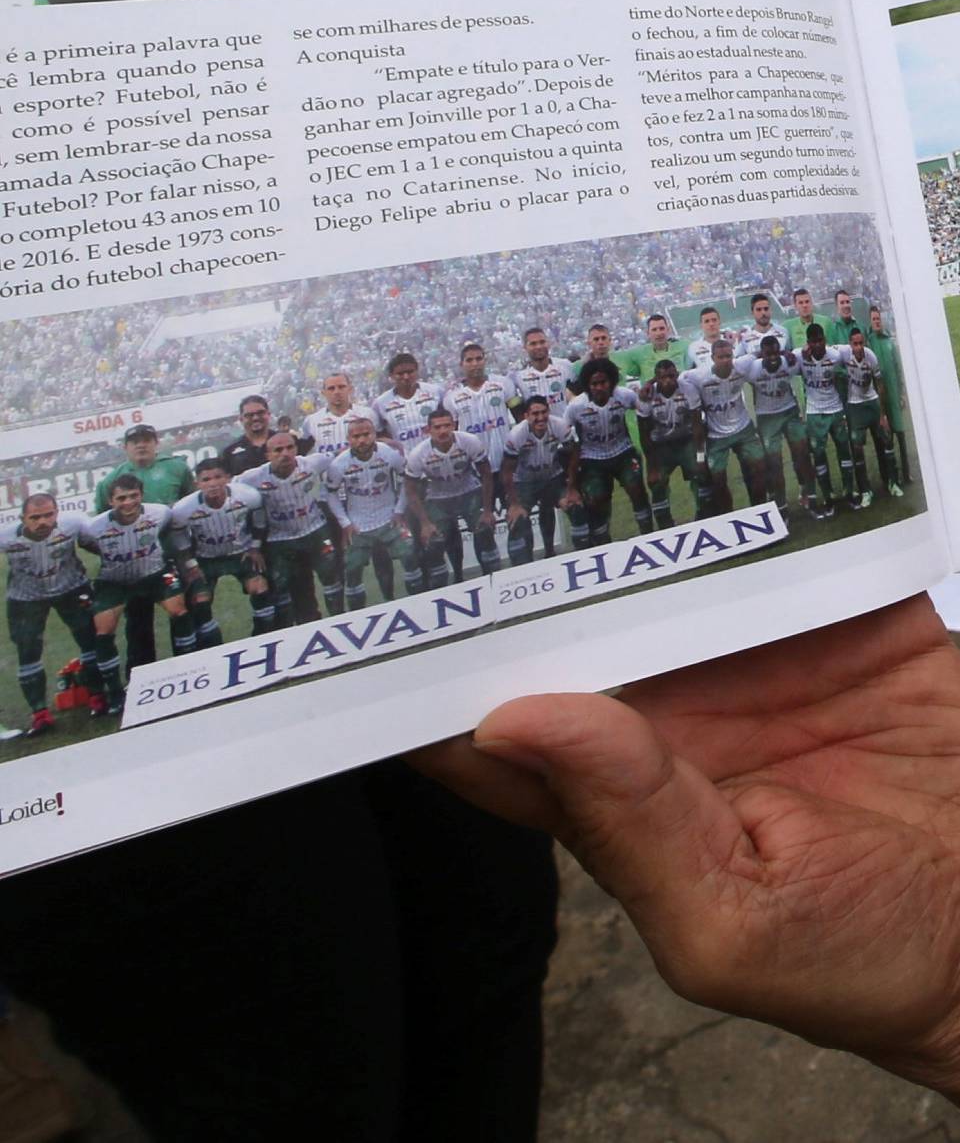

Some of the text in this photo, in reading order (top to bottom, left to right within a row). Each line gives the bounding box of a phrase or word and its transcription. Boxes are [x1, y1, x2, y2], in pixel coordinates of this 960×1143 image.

[294, 15, 535, 39] se com milhares de pessoas.
[6, 35, 262, 65] é a primeira palavra que
[297, 45, 405, 64] A conquista
[458, 65, 468, 75] e
[472, 59, 518, 74] título
[522, 60, 560, 75] para
[564, 59, 573, 68] o
[577, 54, 610, 67] Ver-
[636, 47, 675, 61] finais
[678, 50, 694, 59] ao
[696, 45, 752, 58] estadual
[753, 47, 783, 57] neste
[28, 58, 264, 86] lembra quando pensa
[13, 77, 267, 117] esporte? Futebol, não é
[12, 105, 270, 139] como é possível pensar
[15, 129, 272, 165] sem lembrar-se da nossa
[306, 119, 620, 165] pecoense empatou em Chapecó com
[78, 159, 196, 183] Associação
[202, 153, 274, 171] Chape-
[312, 161, 626, 208] taça no Catarinense. No início,
[654, 175, 680, 189] vel,
[687, 171, 734, 191] porém
[740, 171, 768, 181] com
[774, 164, 849, 181] complexidades
[2, 177, 278, 218] Futebol? Por falar nisso, a
[314, 185, 629, 232] Diego Felipe abriu o placar para o
[657, 195, 708, 211] criação
[711, 194, 735, 205] nas
[737, 189, 769, 203] duas
[770, 185, 818, 204] partidas
[19, 219, 138, 242] completou
[141, 211, 166, 227] 43
[170, 209, 218, 224] anos
[222, 205, 254, 217] em
[258, 197, 280, 213] 10
[22, 226, 283, 269] 2016. E desde 1973 cons-
[51, 275, 80, 291] do
[86, 261, 163, 286] futebol
[170, 251, 286, 275] chapecoen-
[73, 410, 144, 434] SAÍDA 6
[500, 511, 776, 604] 2016 HAVAN
[136, 586, 484, 706] 2016 HAVAN
